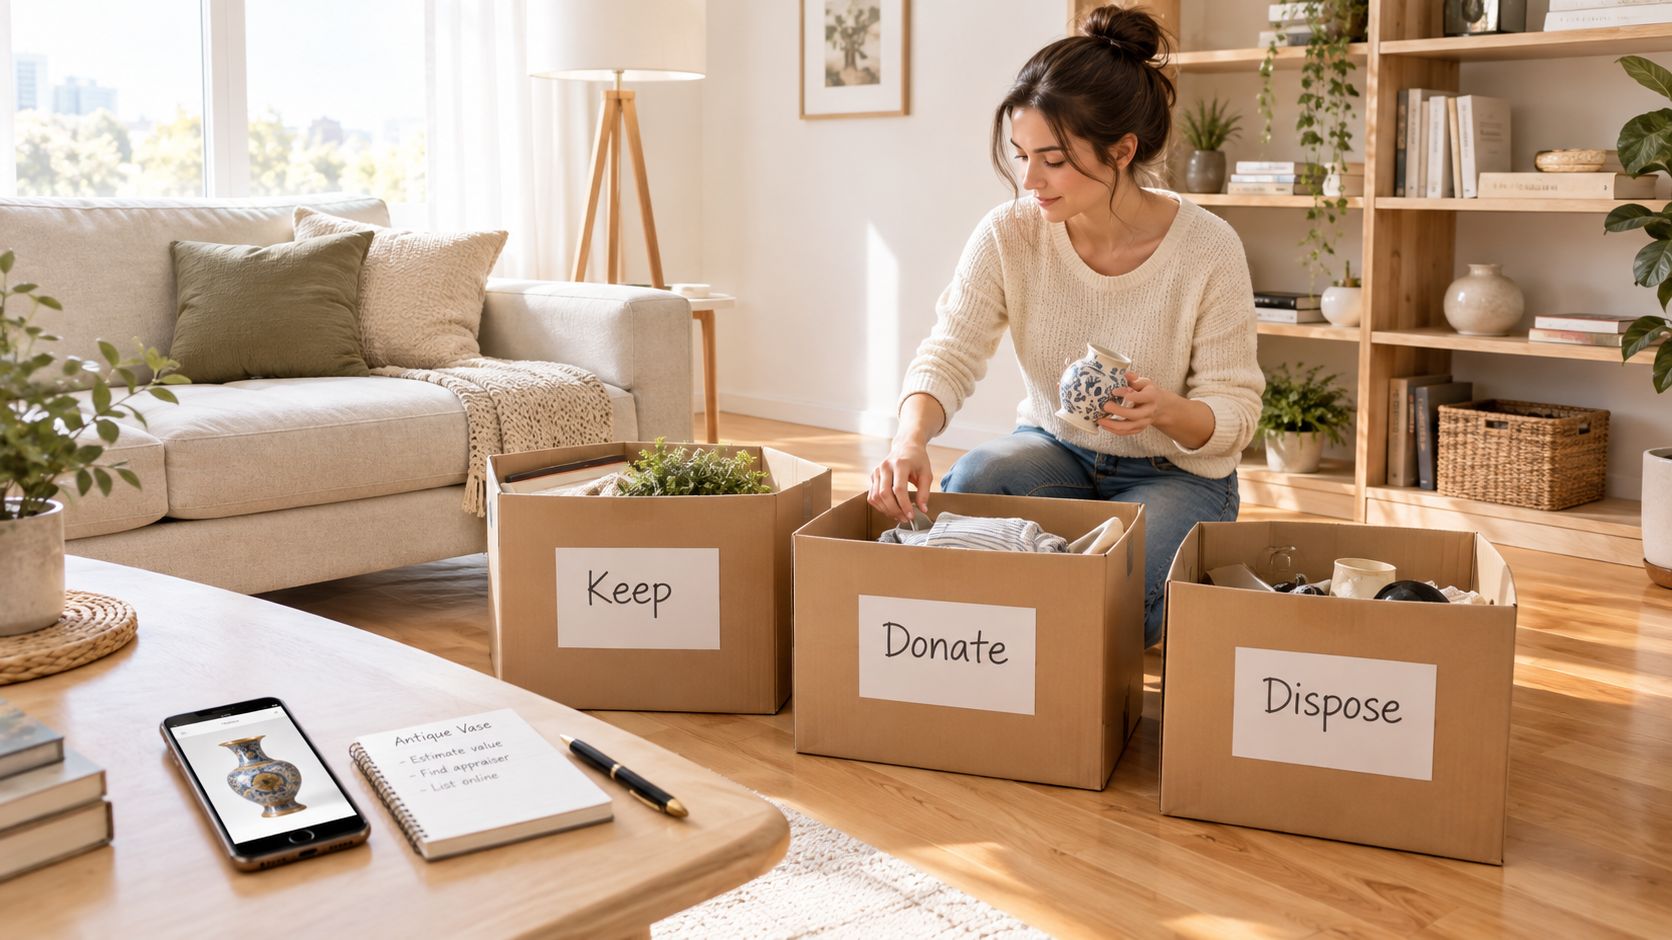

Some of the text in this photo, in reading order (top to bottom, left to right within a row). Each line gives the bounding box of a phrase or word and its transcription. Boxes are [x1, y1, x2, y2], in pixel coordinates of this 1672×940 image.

[588, 570, 672, 618] Keep
[883, 621, 1008, 665] Donate
[1262, 677, 1402, 732] Dispose
[395, 720, 492, 747] Antique Vase
[410, 747, 466, 764] Estimate
[471, 739, 503, 752] value
[420, 767, 448, 778] Find
[453, 754, 510, 772] appraiser
[431, 781, 456, 792] List
[462, 772, 499, 786] online
